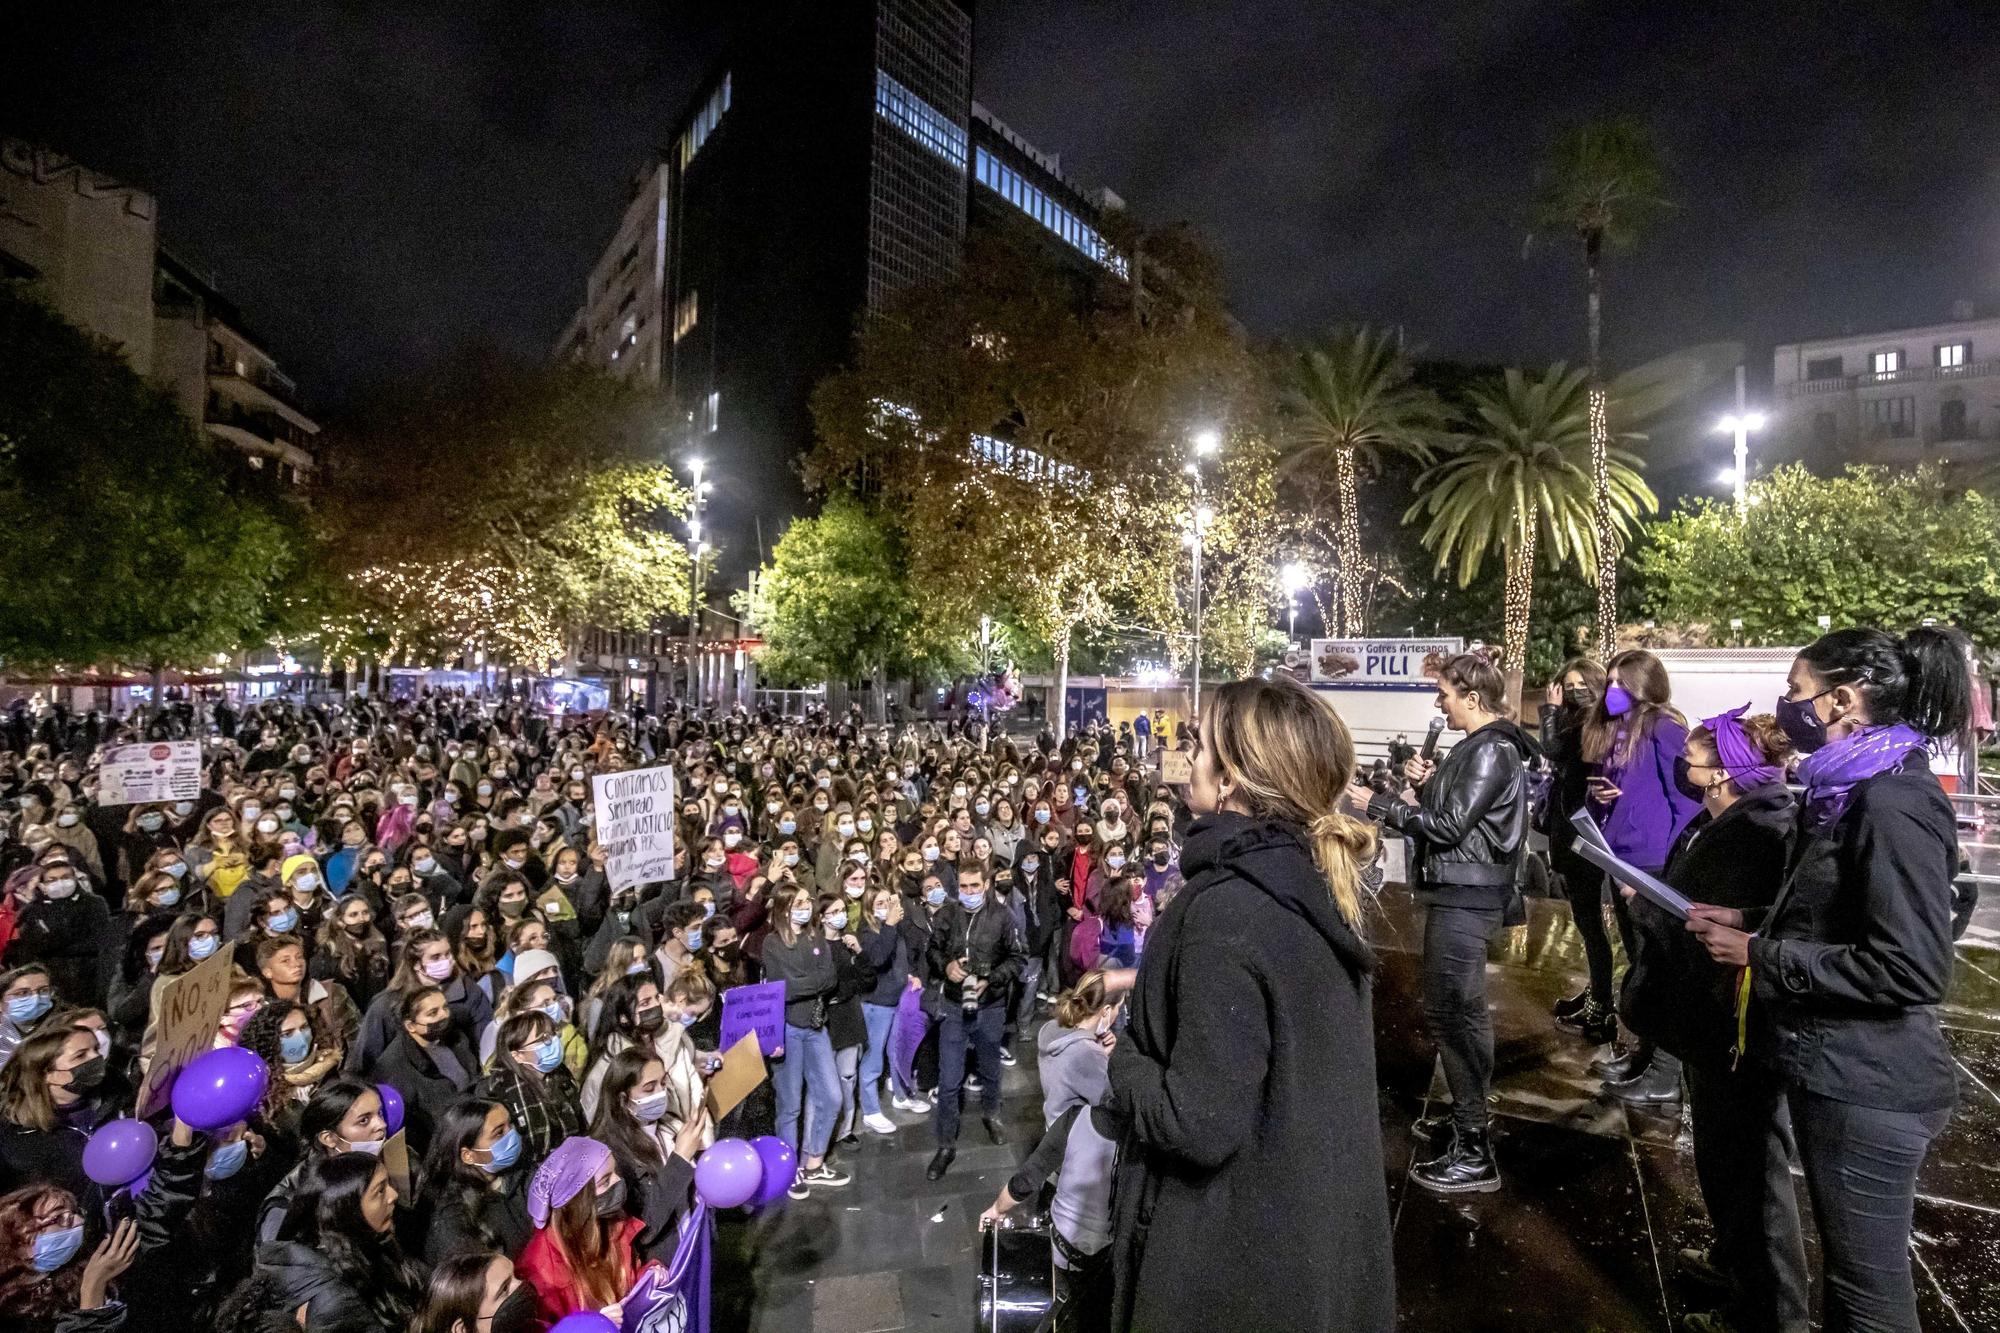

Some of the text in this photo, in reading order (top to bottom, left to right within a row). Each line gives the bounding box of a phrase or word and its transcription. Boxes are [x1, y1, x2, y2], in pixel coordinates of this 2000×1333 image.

[1325, 644, 1356, 653] Crepes
[1366, 644, 1397, 653] Gofres
[1400, 643, 1449, 653] Artesanos
[1366, 655, 1408, 676] PILI
